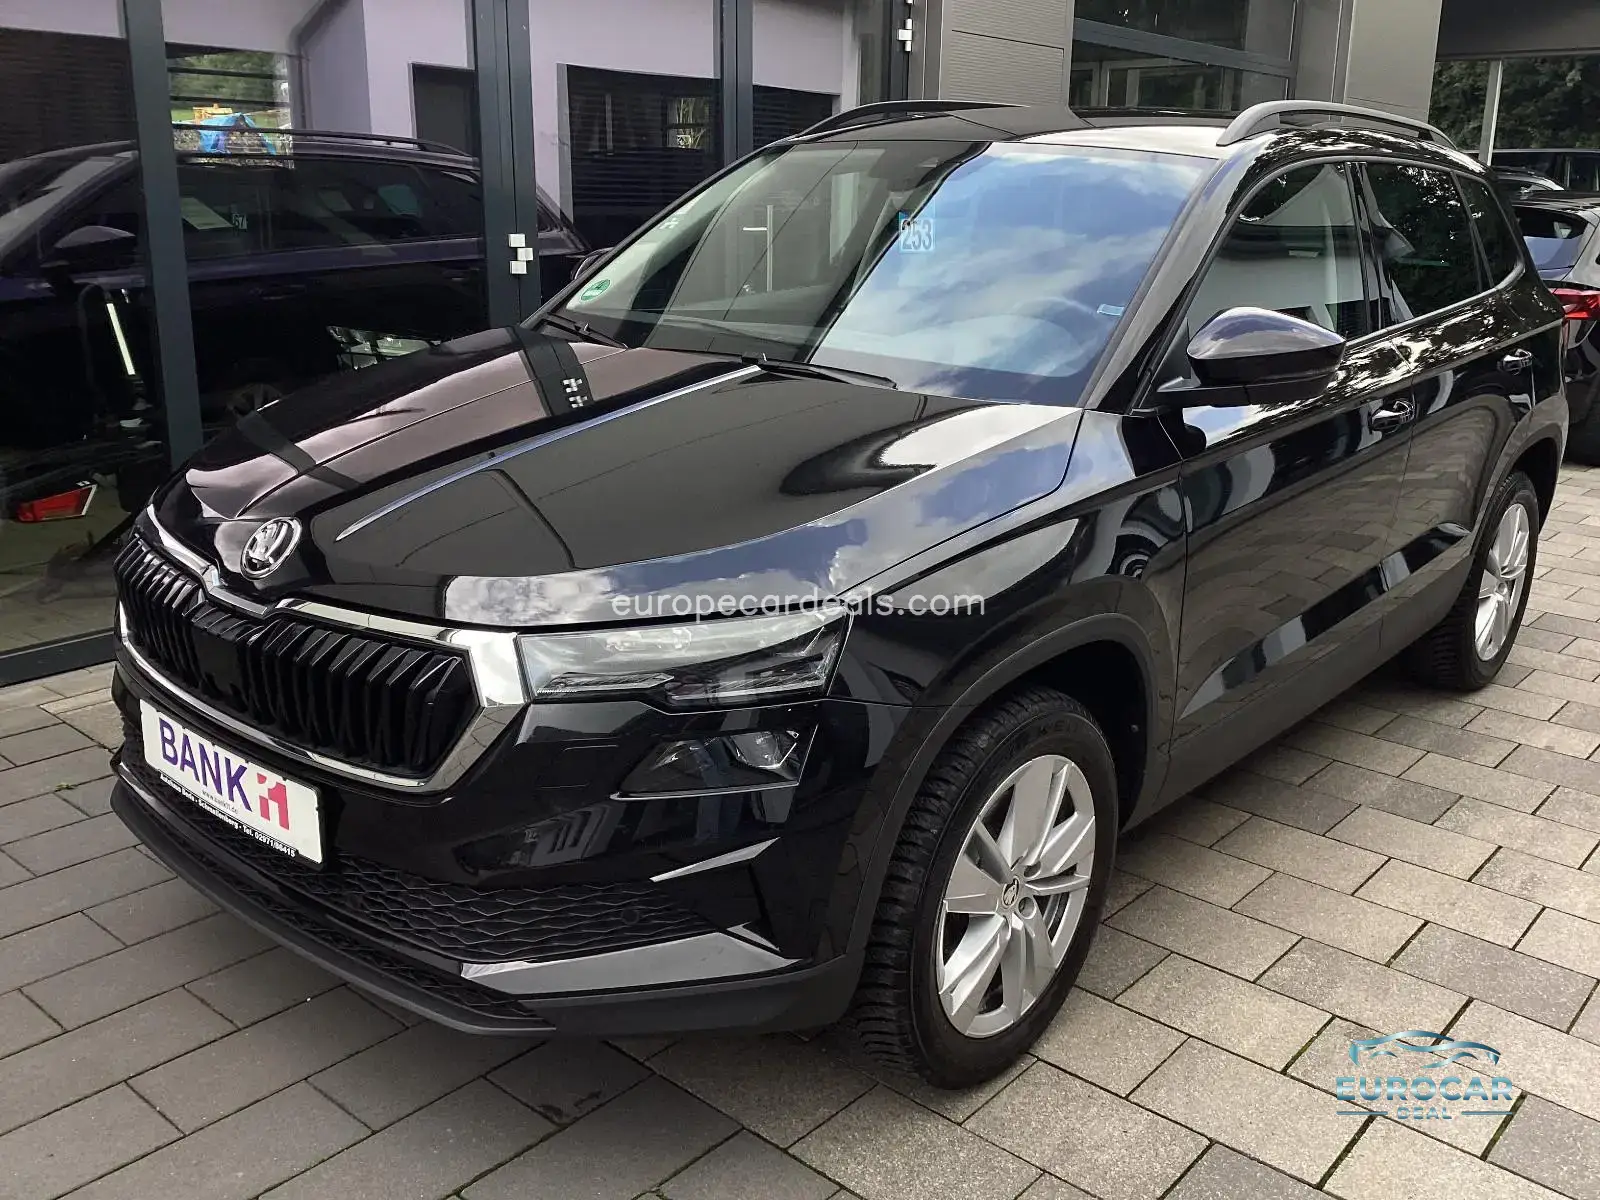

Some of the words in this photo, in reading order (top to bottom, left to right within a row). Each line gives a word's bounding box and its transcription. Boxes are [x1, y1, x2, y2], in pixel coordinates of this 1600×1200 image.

[901, 219, 932, 250] 253
[159, 717, 252, 812] BANK
[243, 824, 254, 837] Tel.
